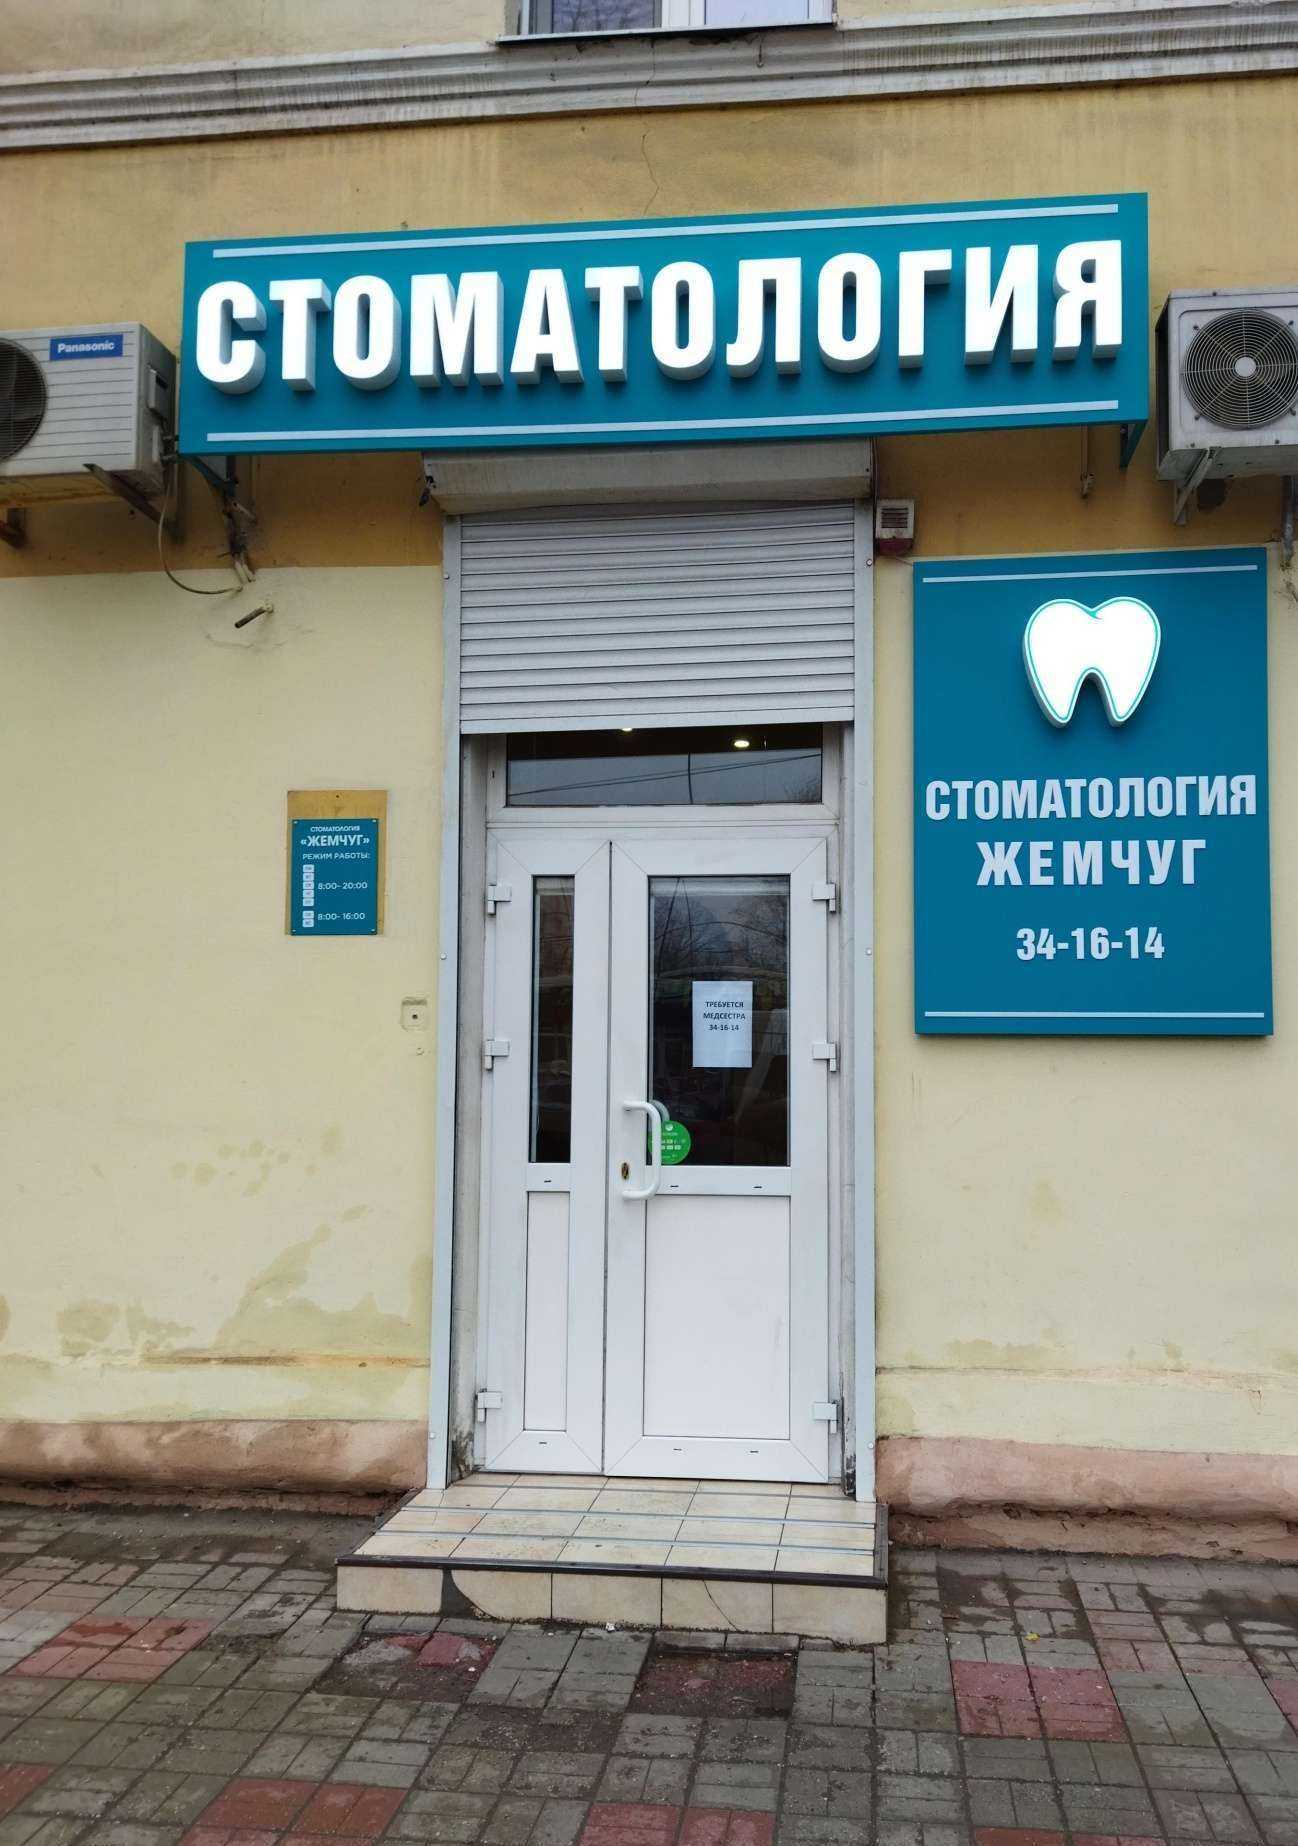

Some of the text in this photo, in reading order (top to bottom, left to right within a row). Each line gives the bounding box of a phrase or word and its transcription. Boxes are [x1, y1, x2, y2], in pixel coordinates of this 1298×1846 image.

[195, 239, 1124, 391] СТОМАТОЛОГИЯ
[57, 340, 115, 353] Panasonic
[925, 774, 1257, 820] СТОМАТОЛОГИЯ
[310, 825, 361, 833] СТОМАТОЛОГИЯ
[300, 834, 370, 847] «ЖЕМЧУГ»
[334, 852, 370, 860] РАБОТЫ:
[976, 838, 1206, 886] ЖЕМЧУГ
[1016, 926, 1165, 961] 34-16-14
[703, 1012, 746, 1020] МЕДСЕСТРА
